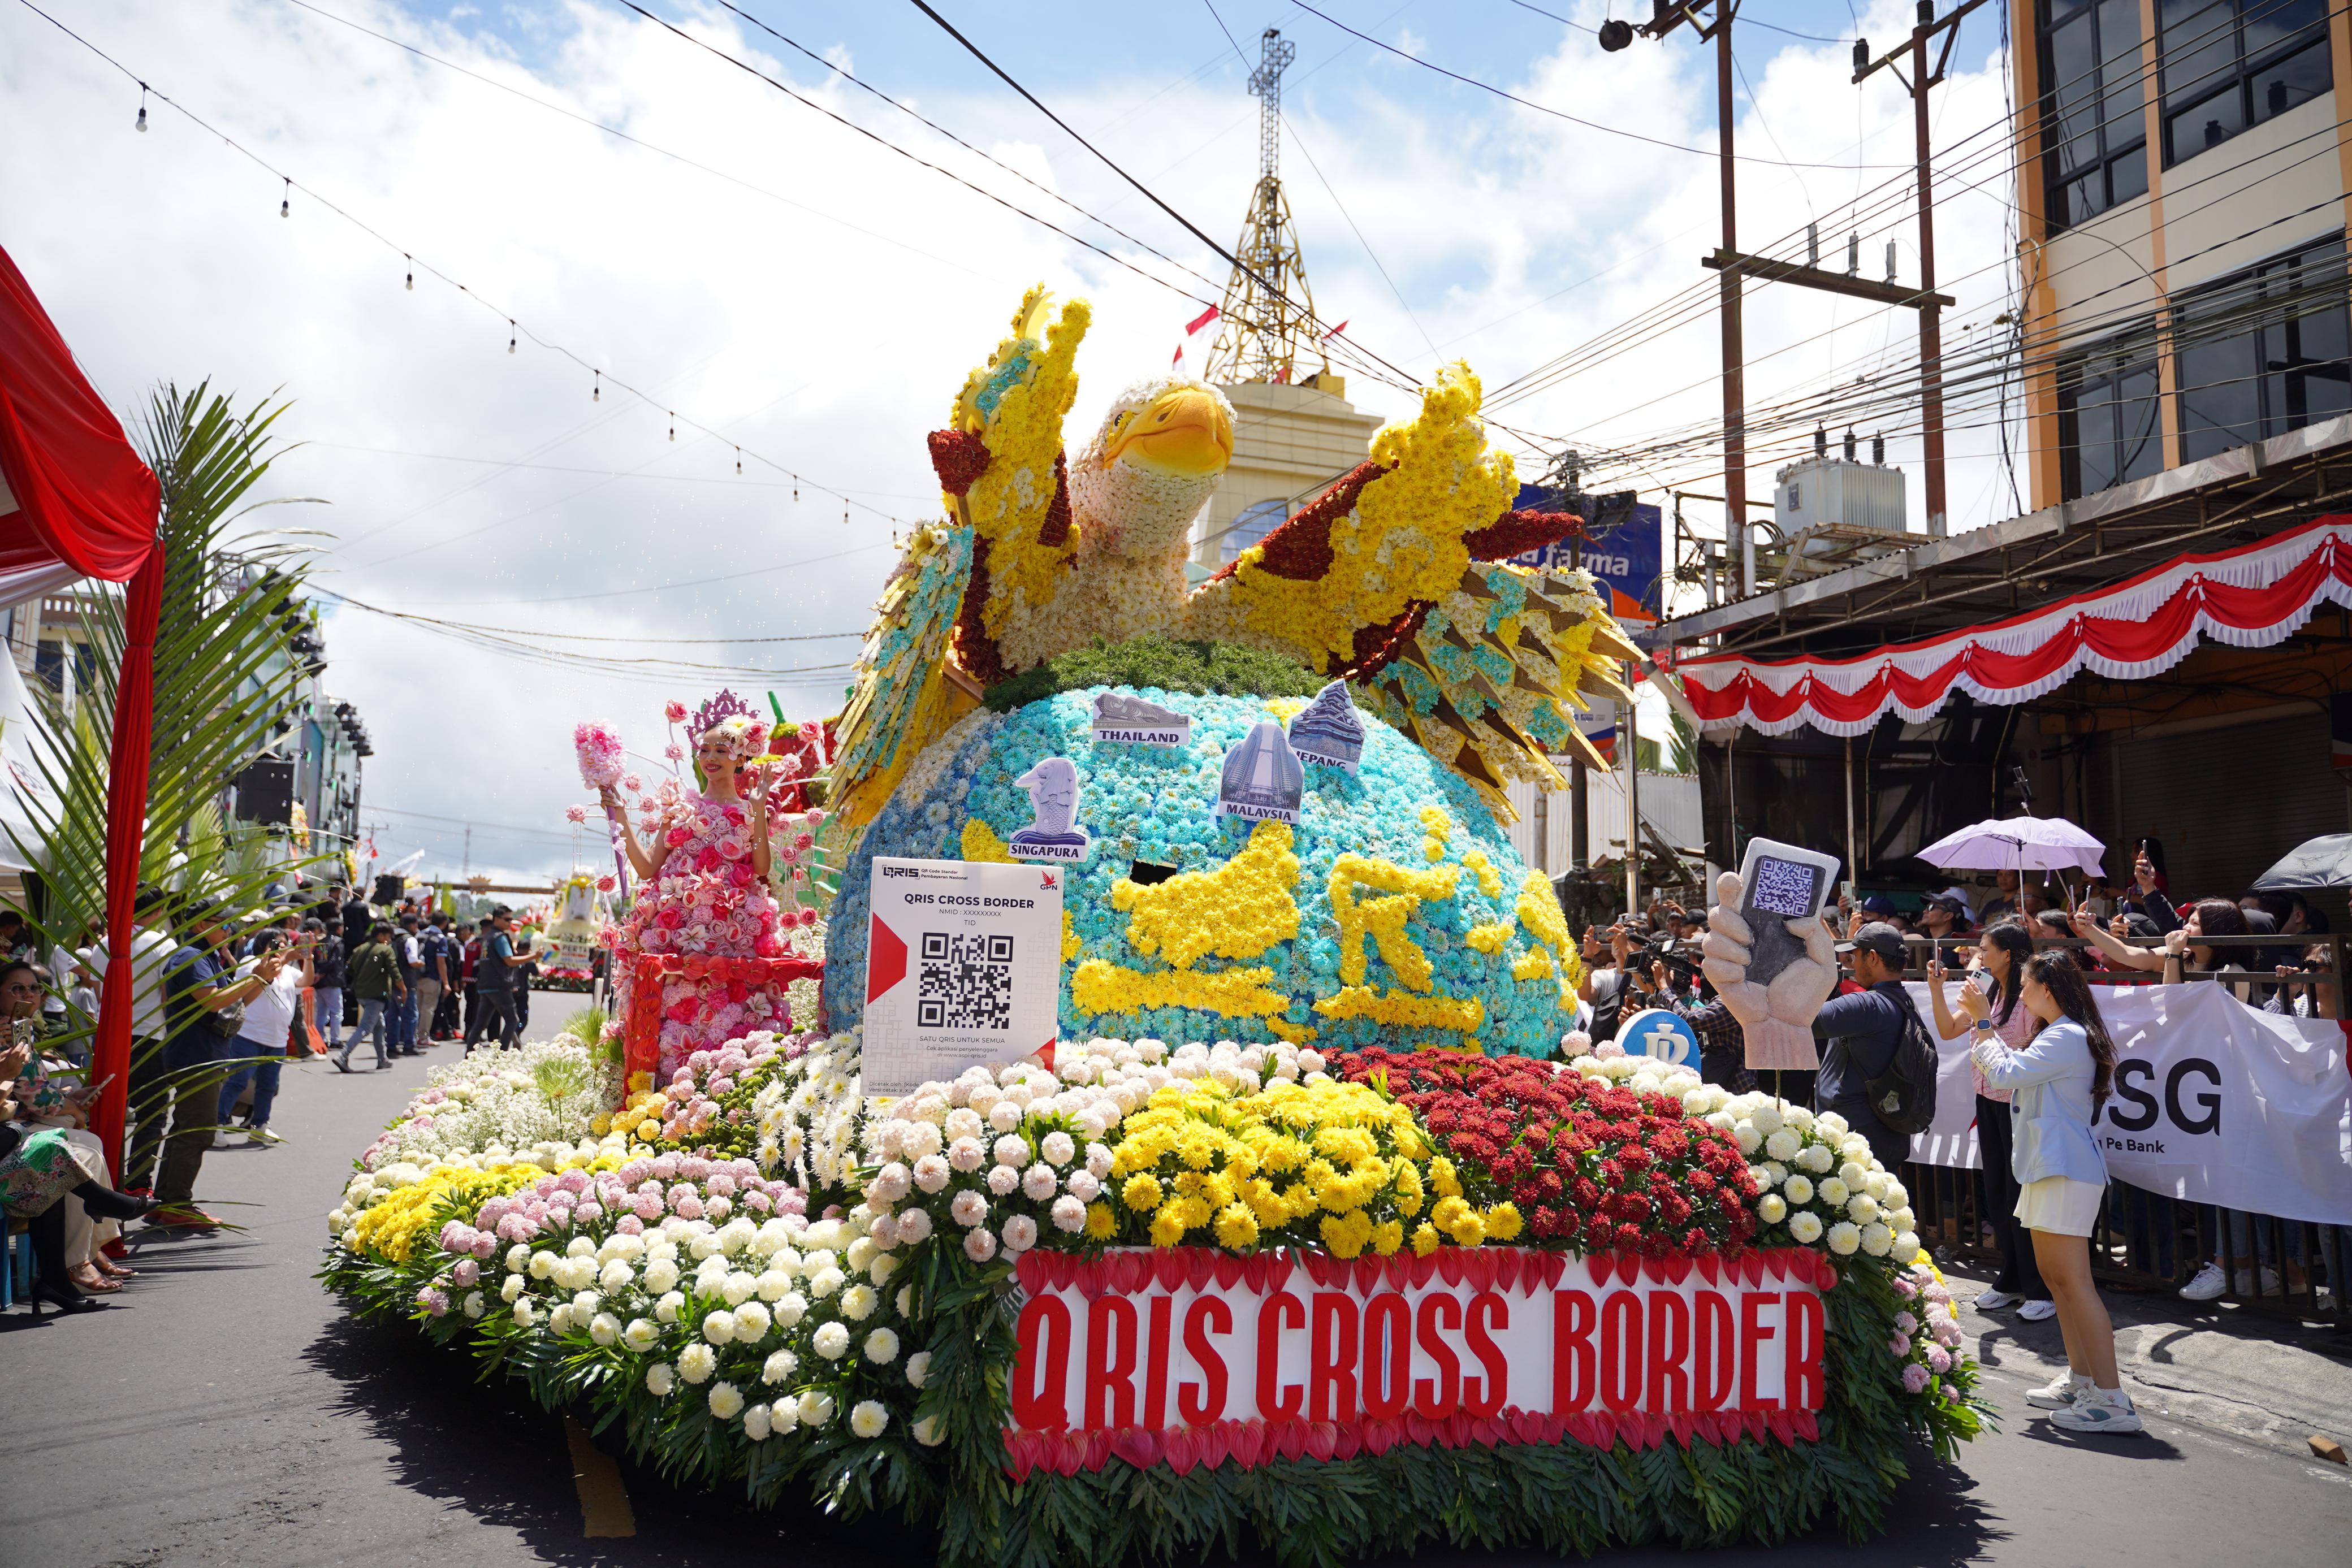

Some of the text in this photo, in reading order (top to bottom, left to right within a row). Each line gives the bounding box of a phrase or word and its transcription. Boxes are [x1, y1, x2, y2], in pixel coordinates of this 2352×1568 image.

[1100, 730, 1179, 743] THAILAND
[1226, 803, 1292, 821] MALAYSIA
[1011, 844, 1079, 858] SINGAPURA
[883, 866, 919, 878] QRIS
[904, 893, 1034, 908] QRIS CROSS BORDER
[2091, 1058, 2221, 1137] SG
[2106, 1137, 2122, 1150] Pe
[2126, 1138, 2165, 1153] Bank
[1012, 1289, 1824, 1432] QRIS CROSS BORDER
